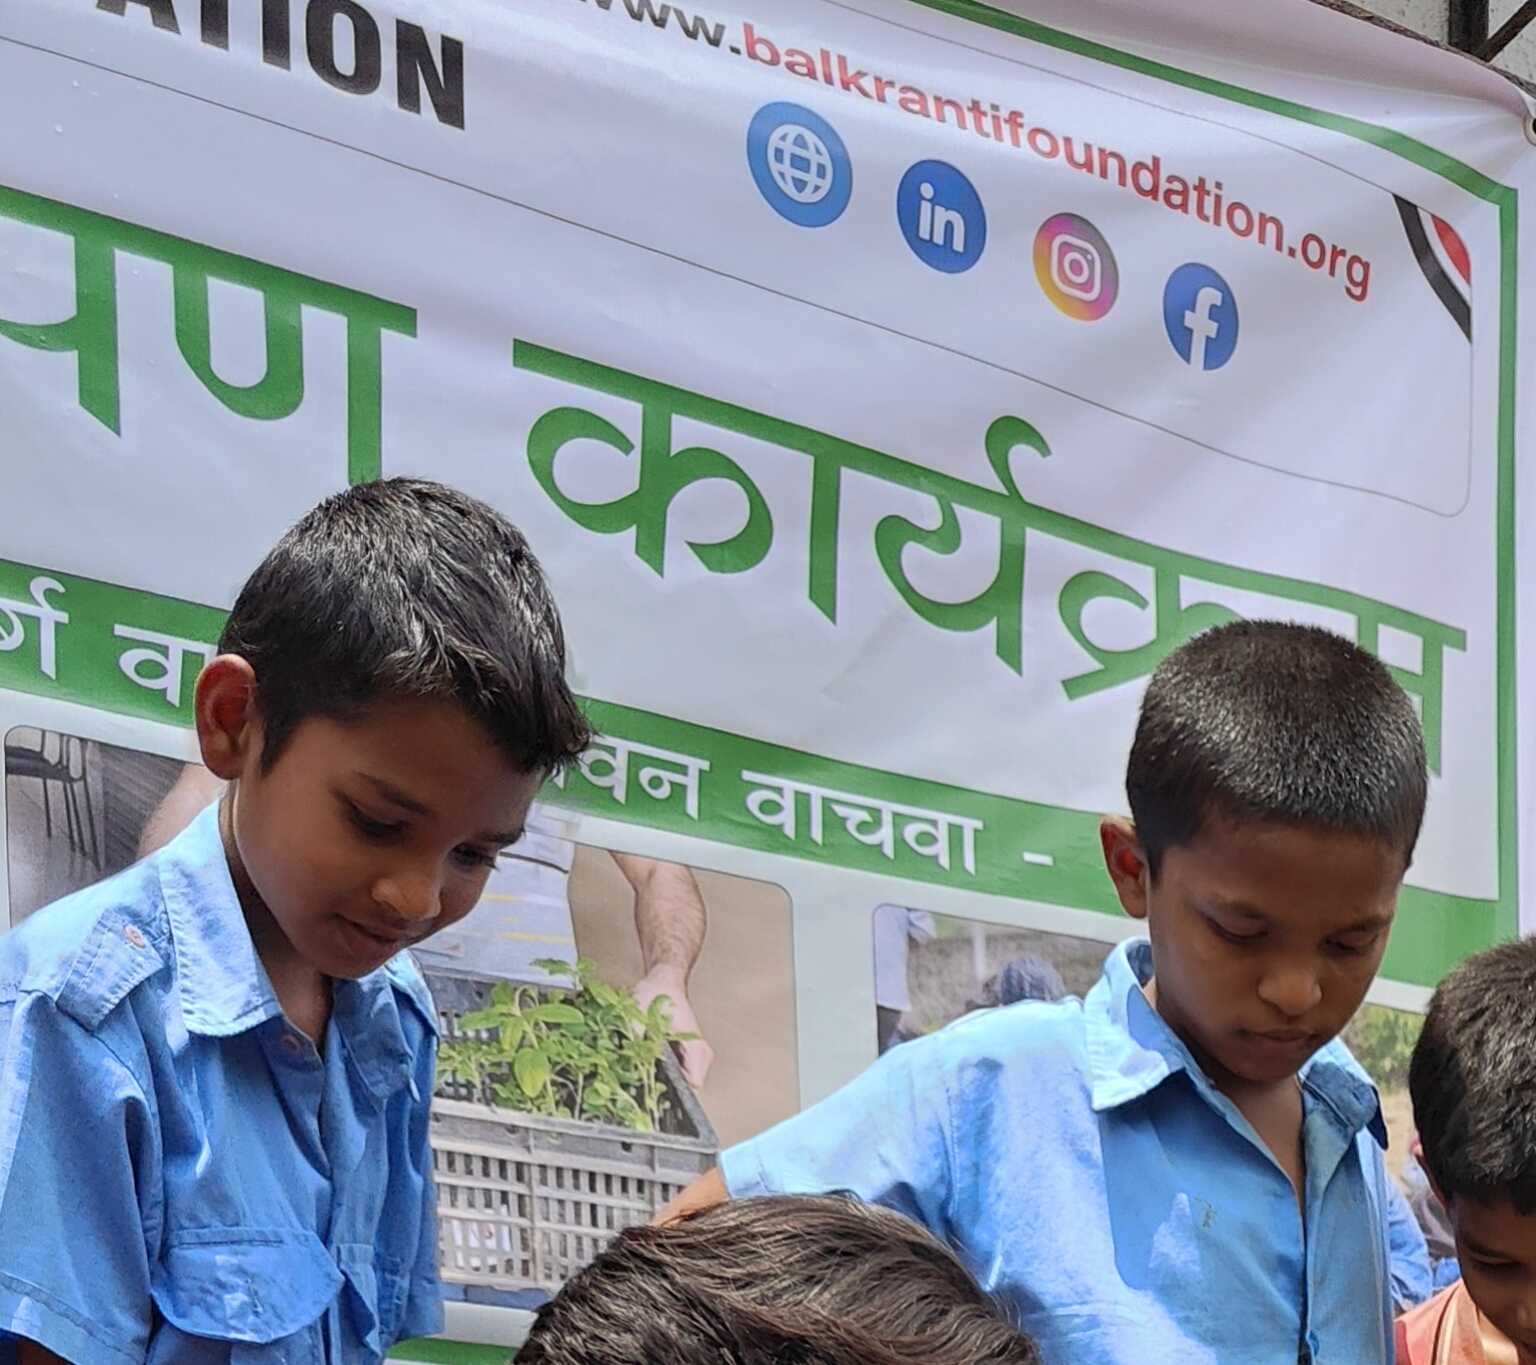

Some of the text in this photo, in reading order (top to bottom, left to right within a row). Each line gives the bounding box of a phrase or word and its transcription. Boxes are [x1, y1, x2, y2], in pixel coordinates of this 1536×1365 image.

[96, 0, 464, 130] ION
[581, 0, 1371, 302] ww.balkrantifoundation.org
[741, 769, 983, 875] वाचवा
